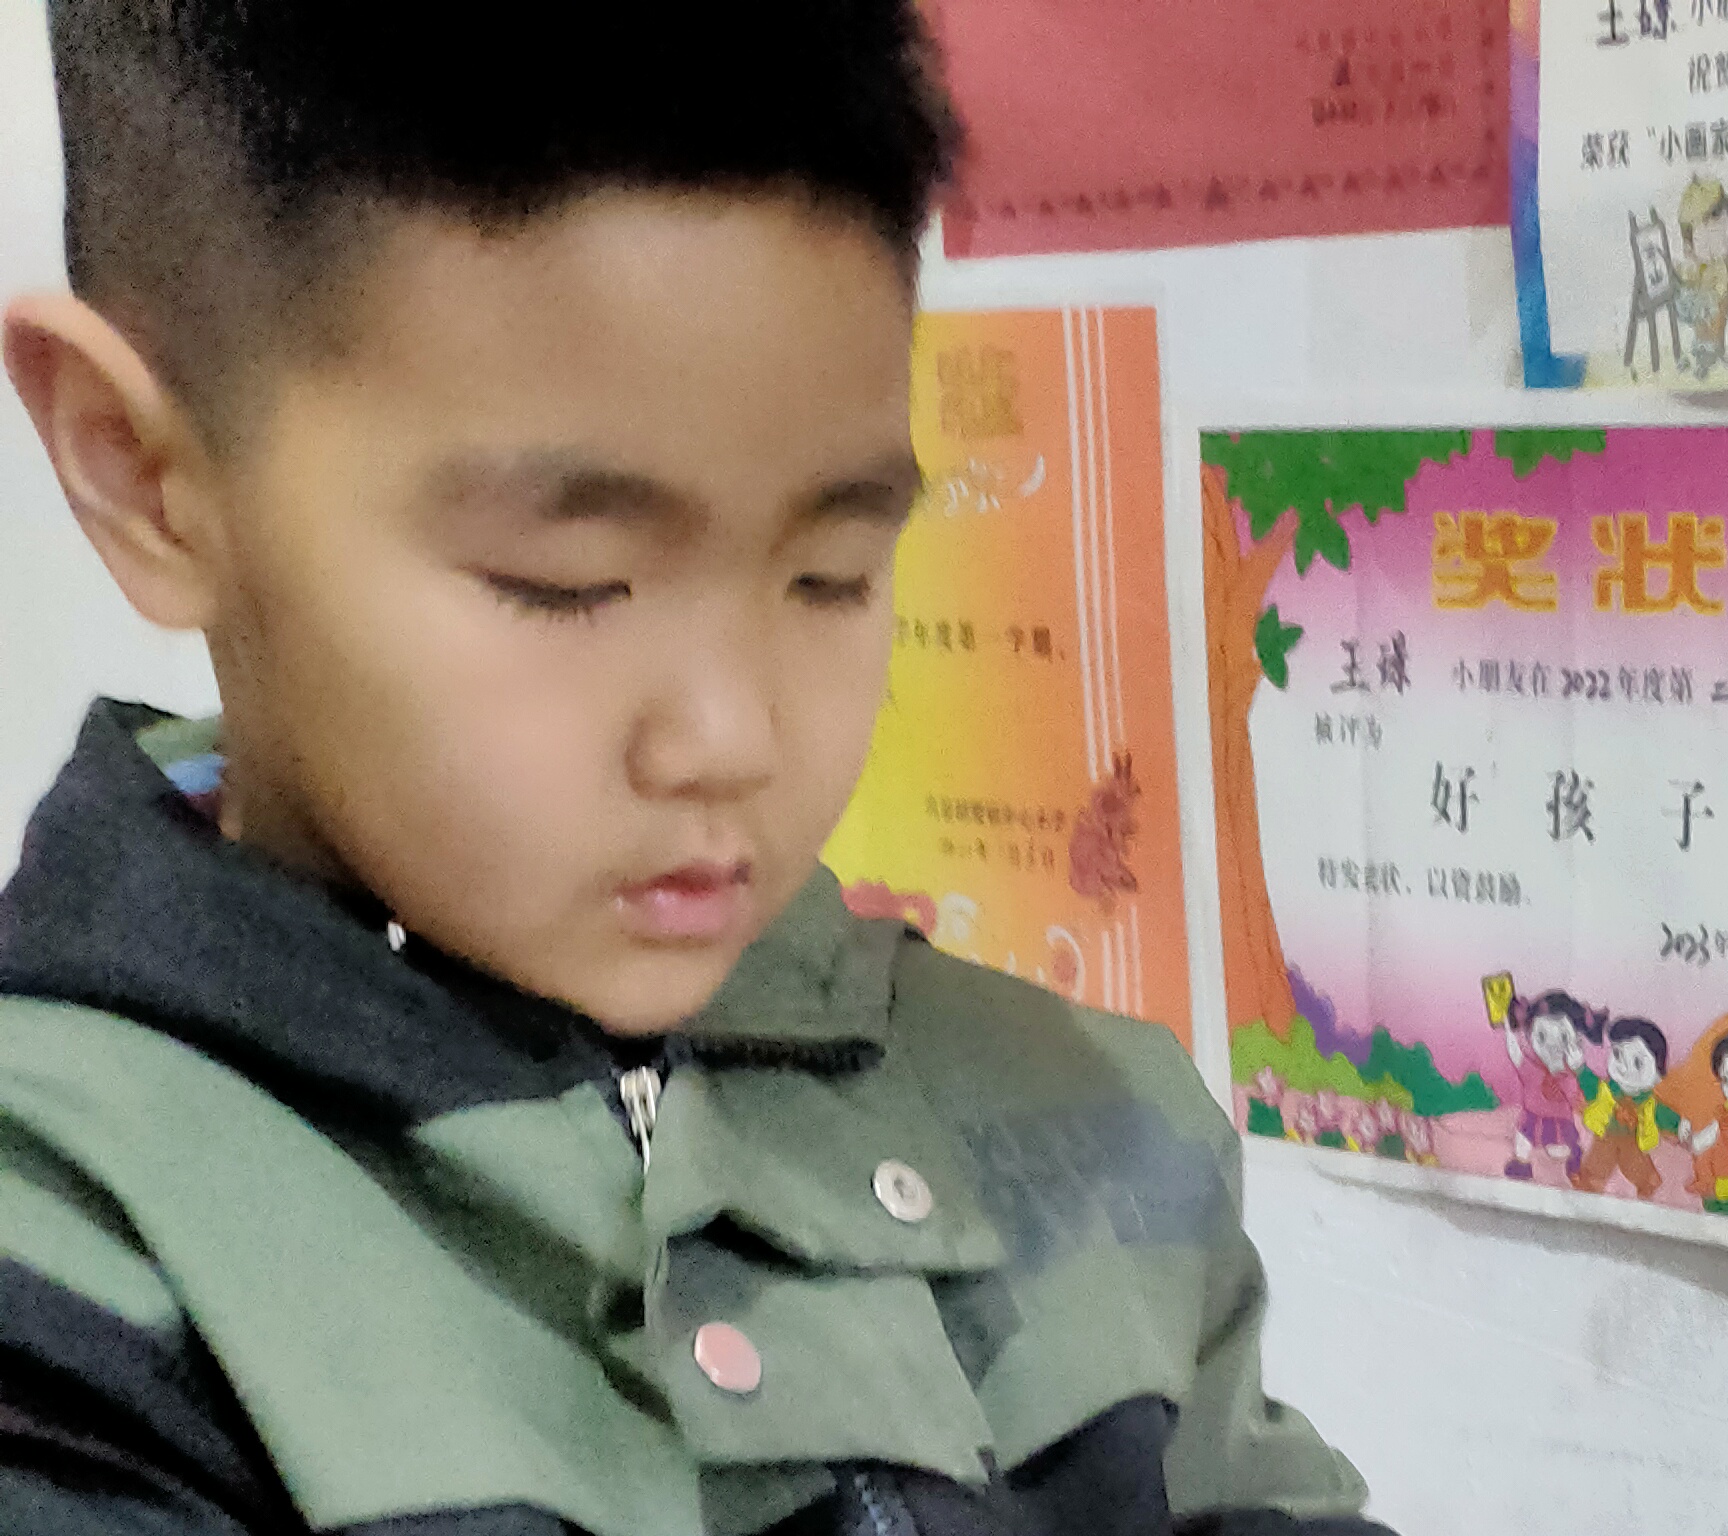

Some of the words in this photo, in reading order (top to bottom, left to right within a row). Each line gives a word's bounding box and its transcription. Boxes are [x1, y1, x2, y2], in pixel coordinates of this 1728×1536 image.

[1431, 511, 1726, 612] 奖状
[1431, 762, 1716, 852] 好孩子
